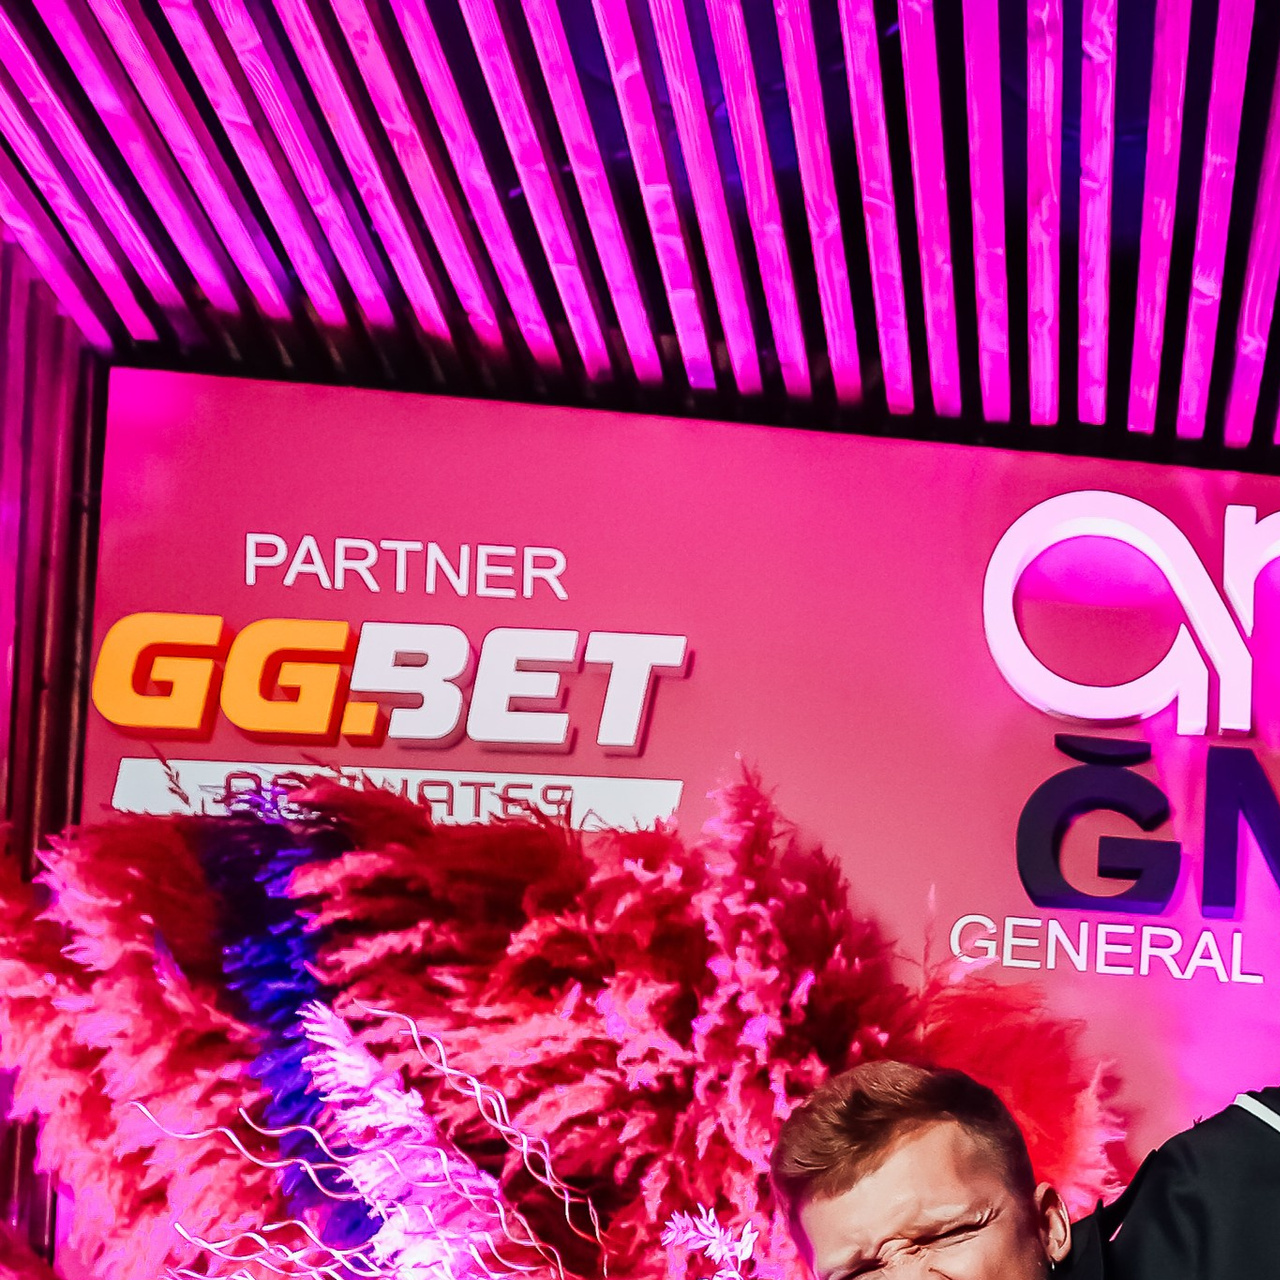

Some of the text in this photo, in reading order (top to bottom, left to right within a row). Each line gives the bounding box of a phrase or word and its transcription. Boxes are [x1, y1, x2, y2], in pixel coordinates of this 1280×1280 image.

[245, 532, 569, 600] PARTNER
[92, 612, 687, 746] GG.BET
[949, 913, 1263, 984] GENERAL
